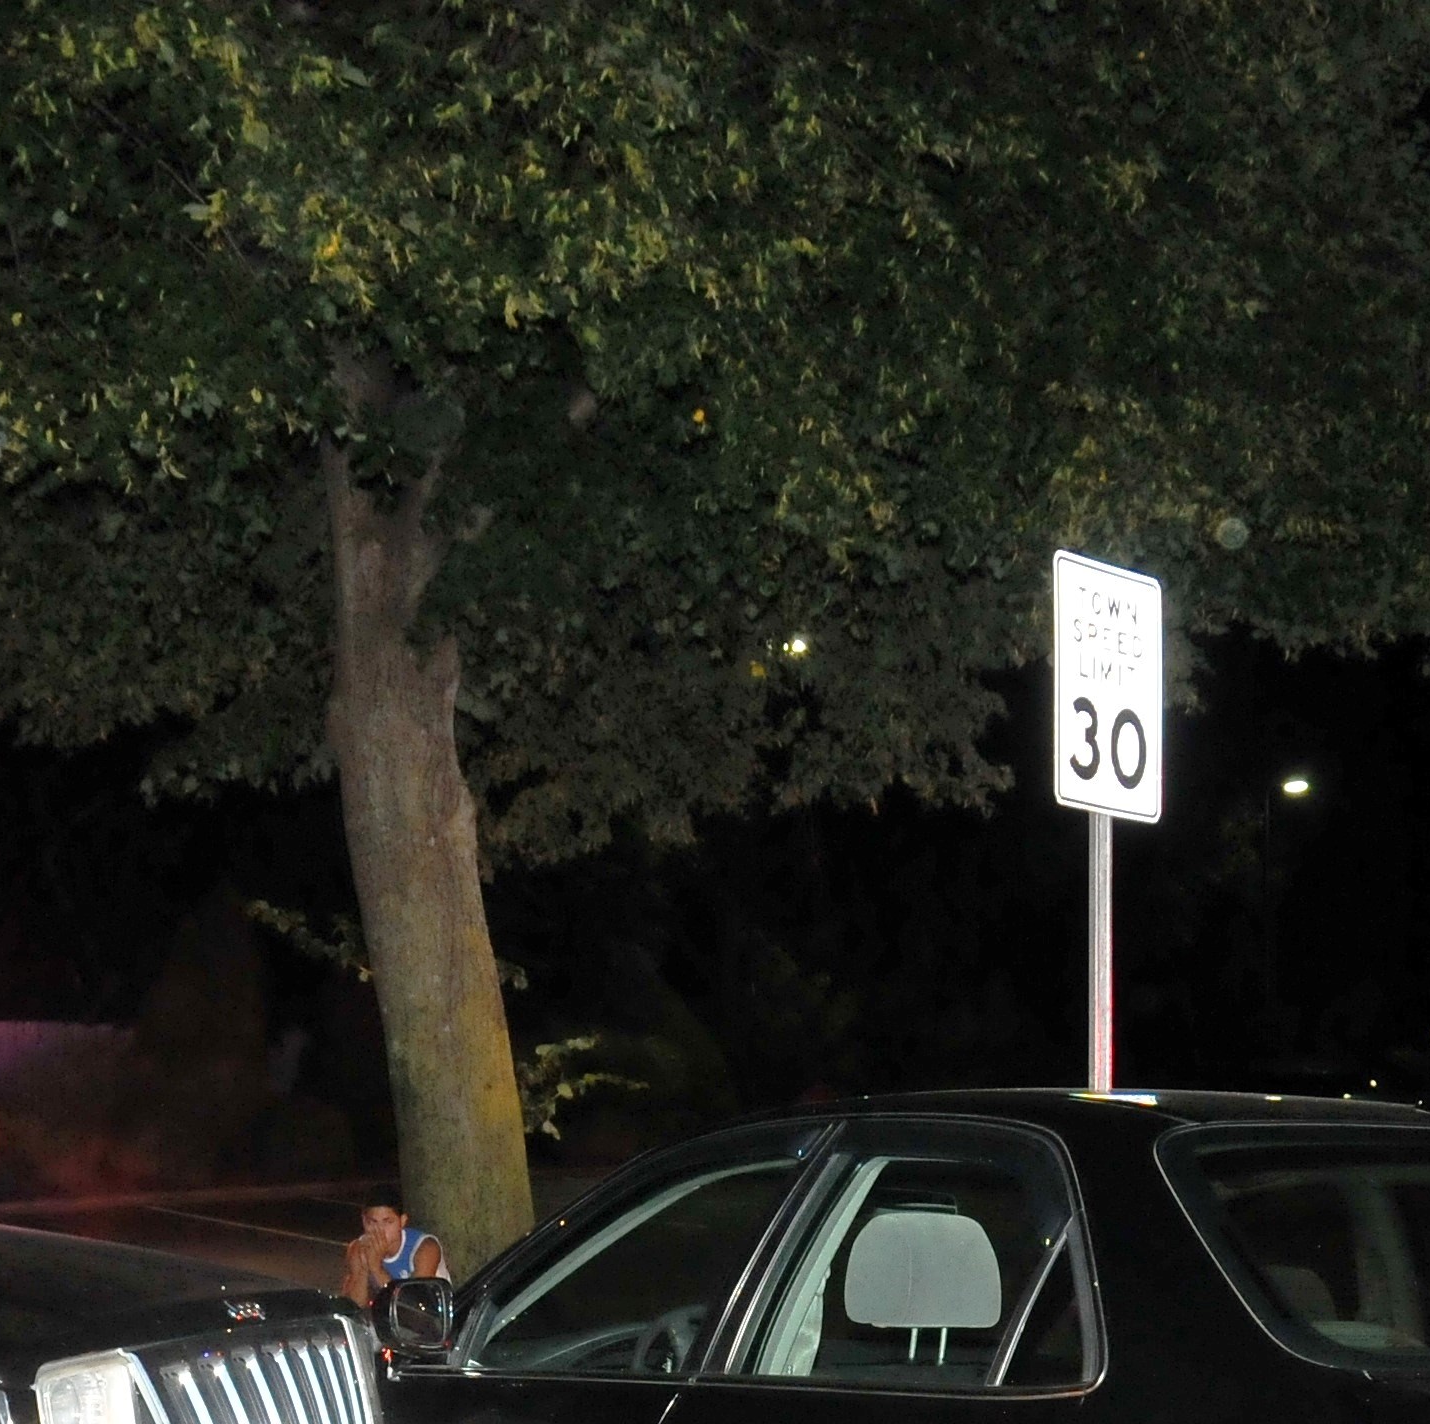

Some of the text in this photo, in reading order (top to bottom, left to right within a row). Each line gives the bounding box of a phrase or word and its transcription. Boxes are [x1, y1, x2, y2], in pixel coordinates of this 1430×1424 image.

[1078, 586, 1138, 625] TOWN
[1074, 618, 1143, 659] SPEED
[1079, 653, 1137, 686] LIMIT
[1070, 696, 1147, 790] 30
